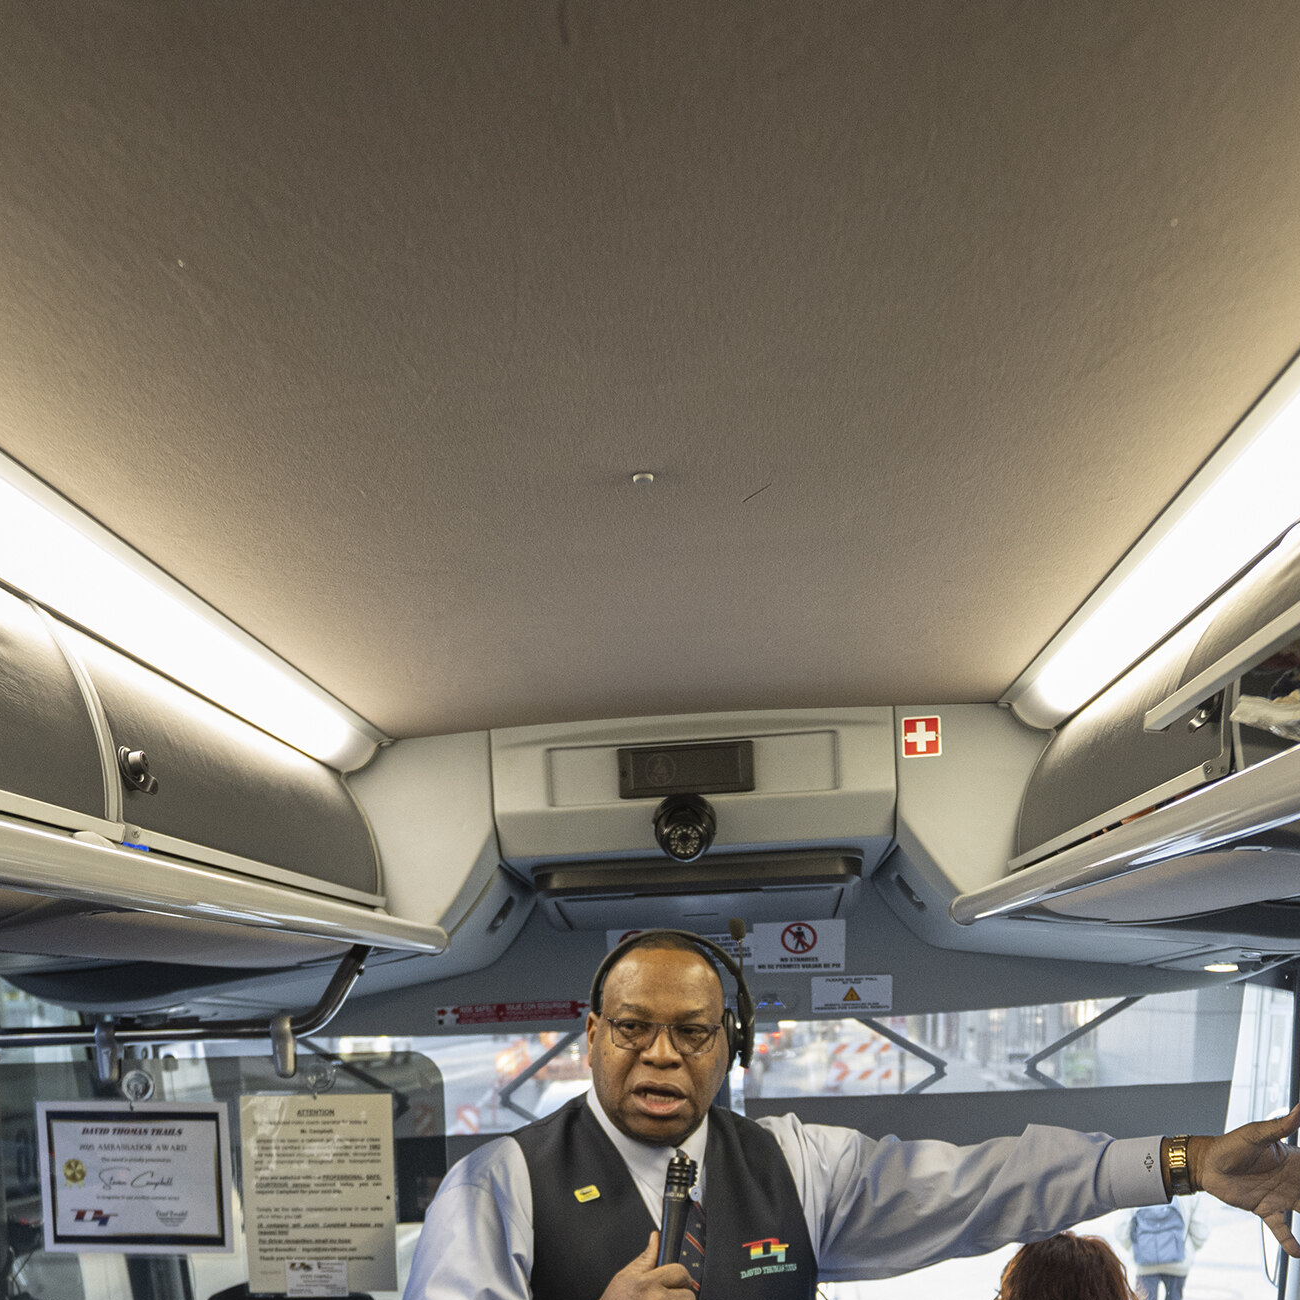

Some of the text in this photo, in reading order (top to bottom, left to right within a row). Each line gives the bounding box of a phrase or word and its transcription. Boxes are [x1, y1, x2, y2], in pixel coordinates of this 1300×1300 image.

[297, 1108, 335, 1117] ATTENTION
[82, 1127, 110, 1136] DAVID
[111, 1127, 148, 1136] THOMAS
[98, 1144, 152, 1152] AMBASSADOR
[155, 1144, 188, 1152] AWARD
[130, 1170, 173, 1191] Campbell
[740, 1266, 762, 1280] DAVID
